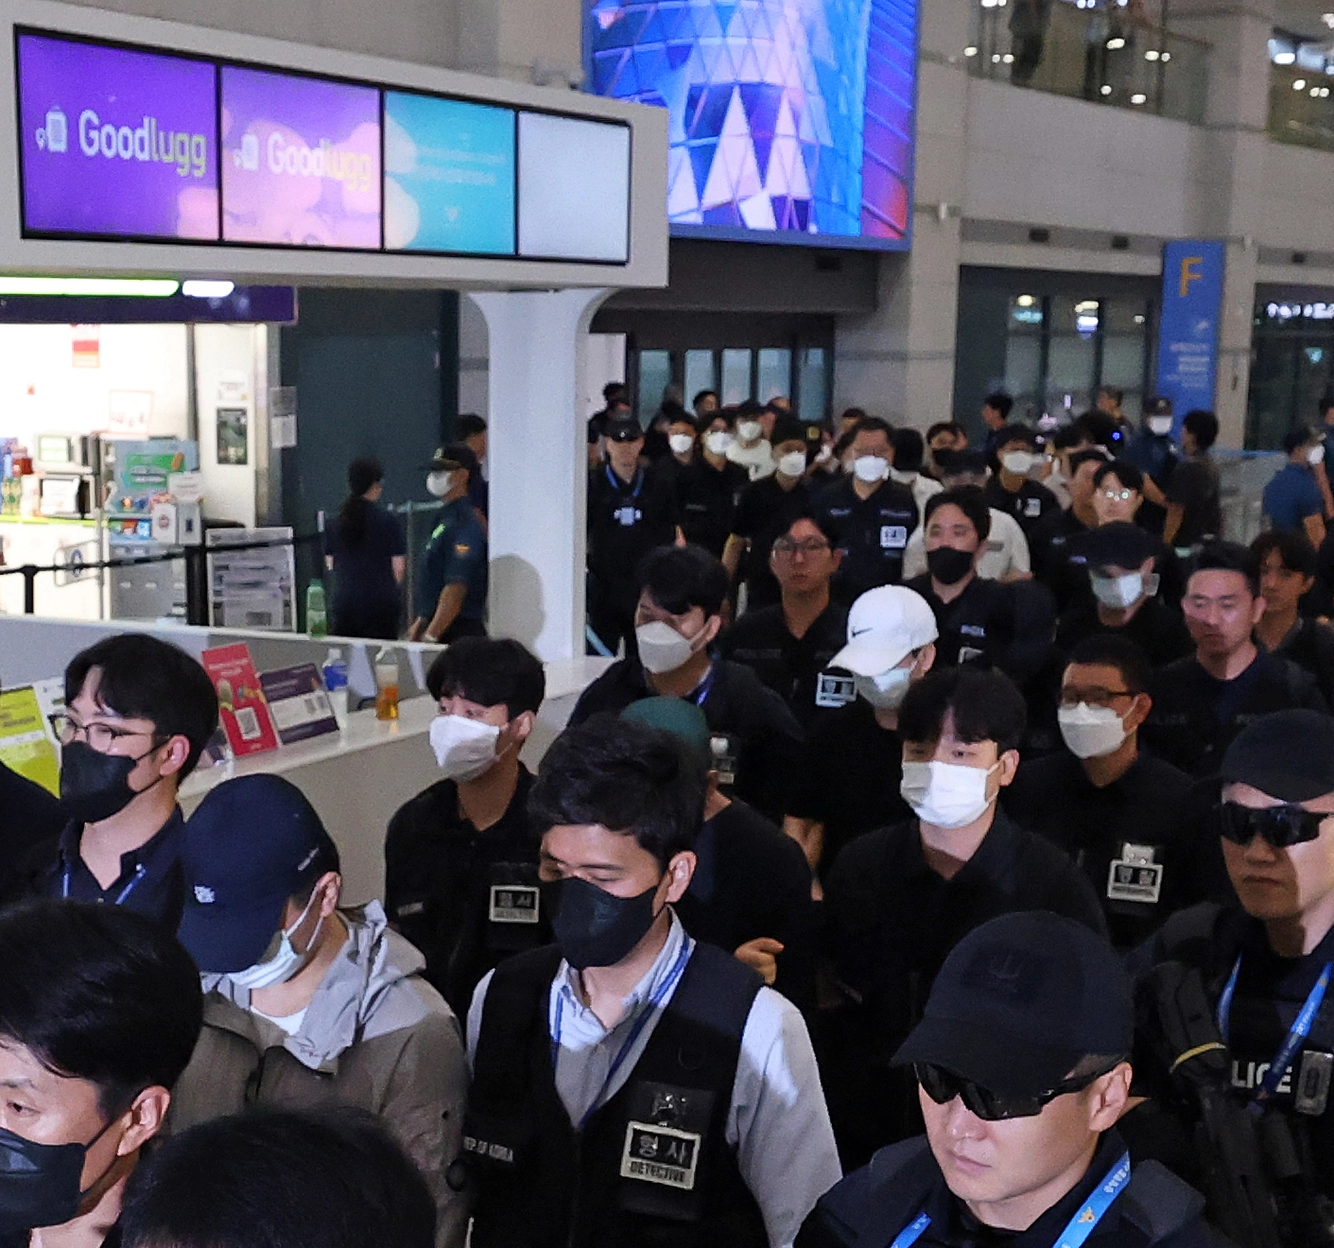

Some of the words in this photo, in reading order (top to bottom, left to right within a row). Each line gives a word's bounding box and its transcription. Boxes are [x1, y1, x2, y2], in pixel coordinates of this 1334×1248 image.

[79, 109, 207, 177] Goodlugg
[267, 131, 371, 191] Goodlugg
[1179, 257, 1204, 297] F
